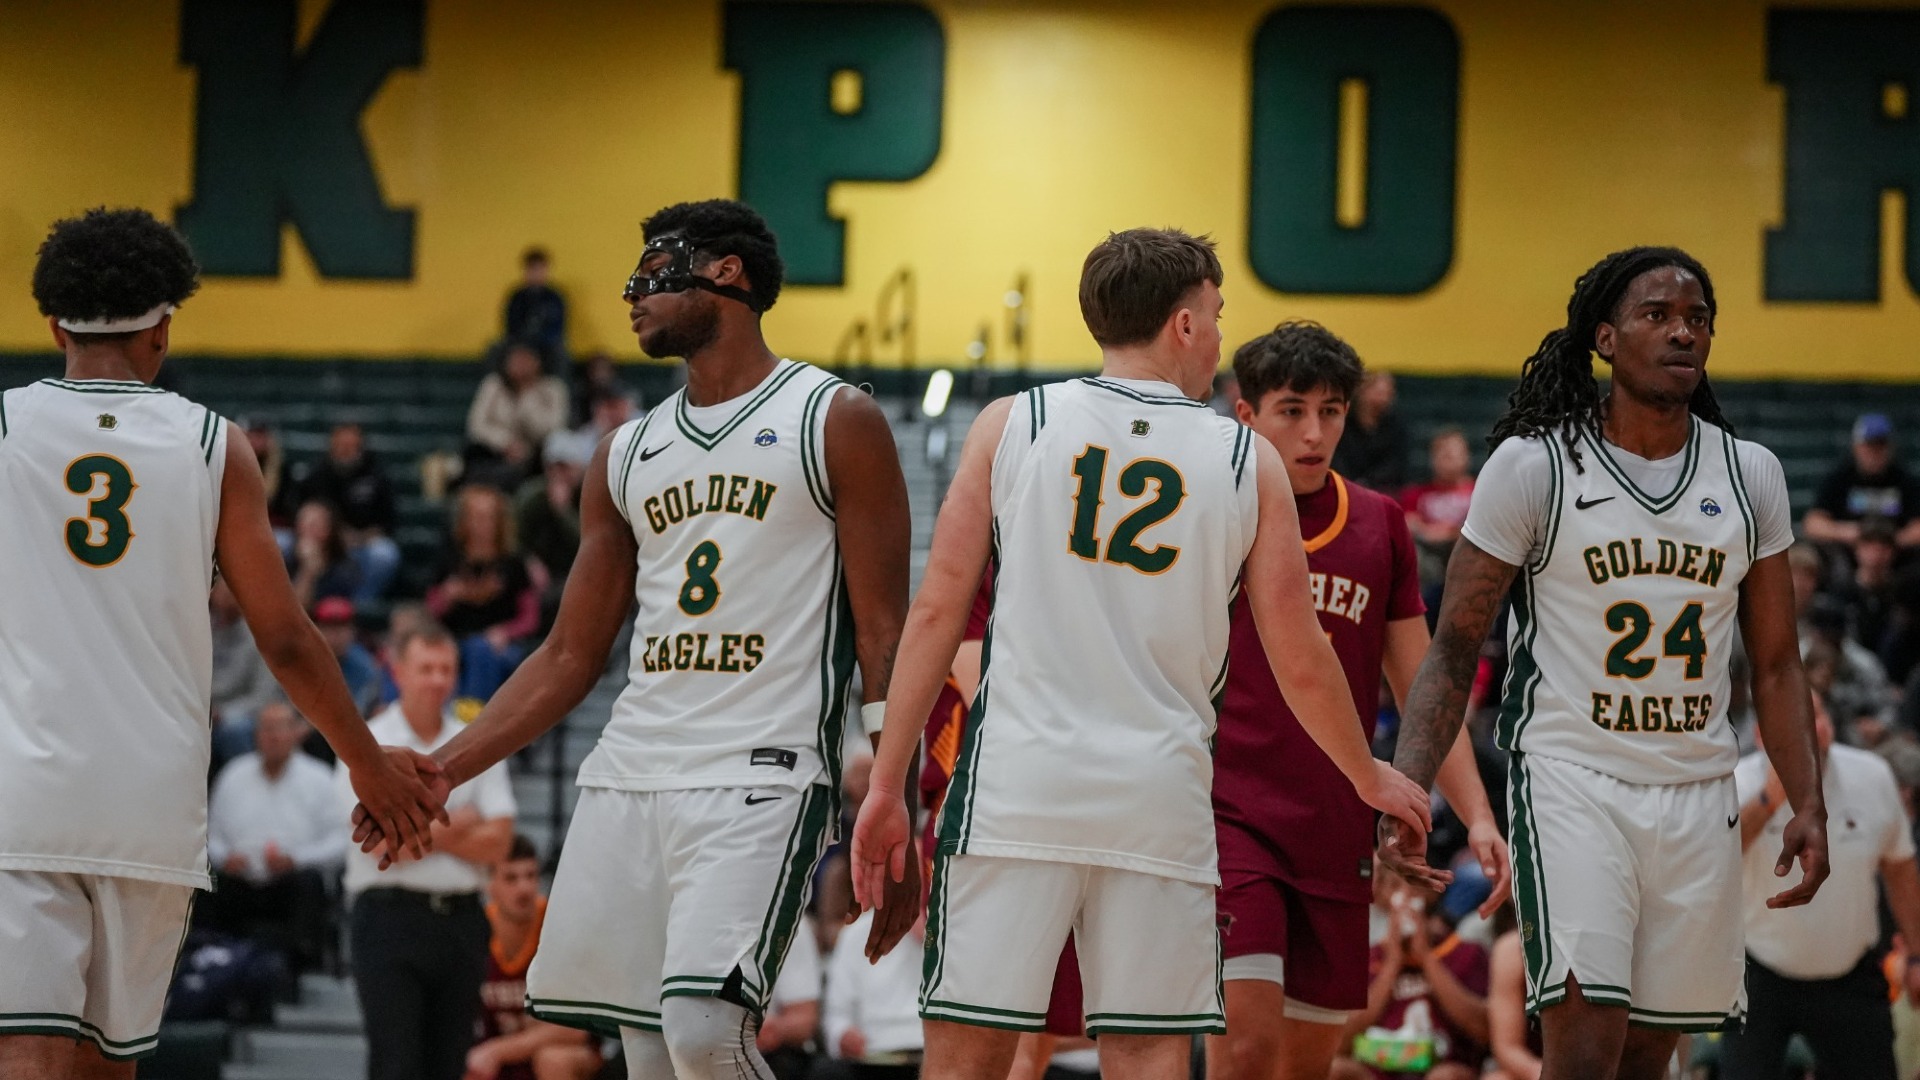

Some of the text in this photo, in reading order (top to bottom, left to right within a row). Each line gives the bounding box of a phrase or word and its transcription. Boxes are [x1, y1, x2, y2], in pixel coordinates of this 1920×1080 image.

[64, 453, 140, 568] 3
[644, 474, 778, 535] GOLDEN
[1067, 443, 1189, 576] 12
[677, 538, 724, 618] 8
[1583, 538, 1726, 588] GOLDEN
[642, 632, 765, 674] EAGLES
[1604, 600, 1707, 681] 24
[1592, 692, 1713, 734] EAGLES
